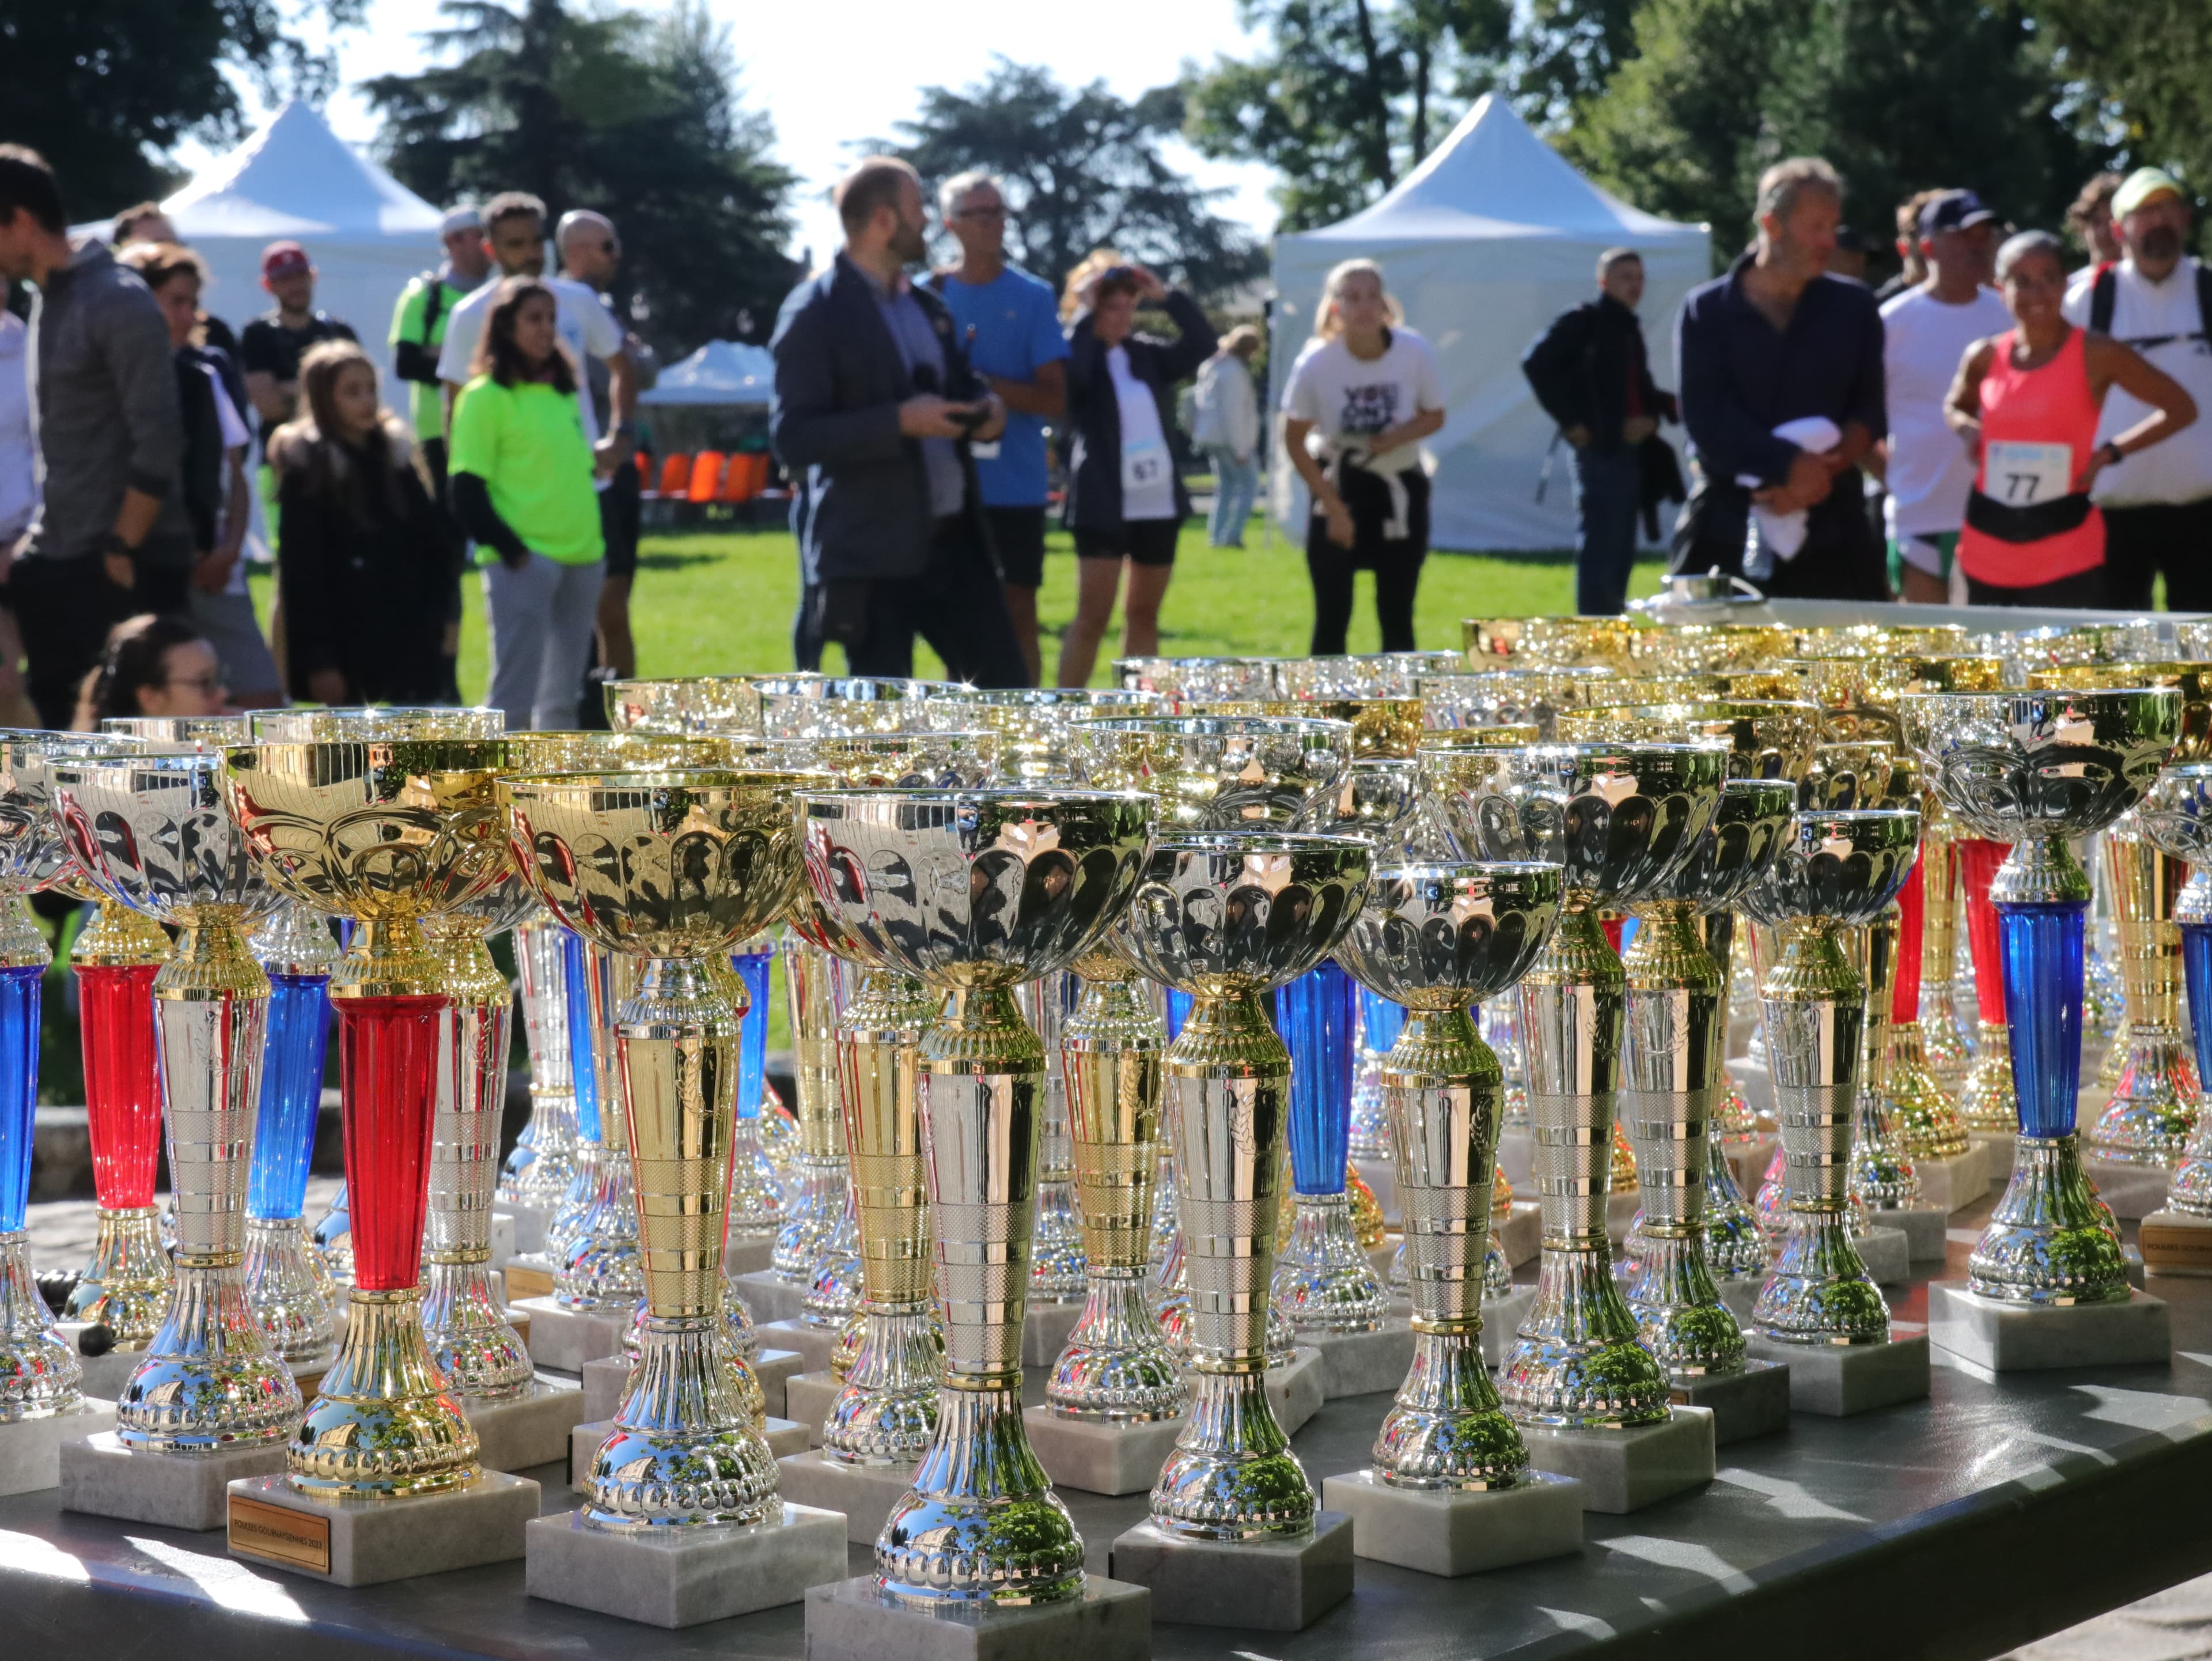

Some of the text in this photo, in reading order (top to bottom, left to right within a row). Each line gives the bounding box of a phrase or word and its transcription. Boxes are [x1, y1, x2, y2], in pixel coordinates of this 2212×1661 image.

[2006, 472, 2040, 500] 77
[234, 1519, 257, 1533] FOULEES
[308, 1538, 322, 1549] 2023
